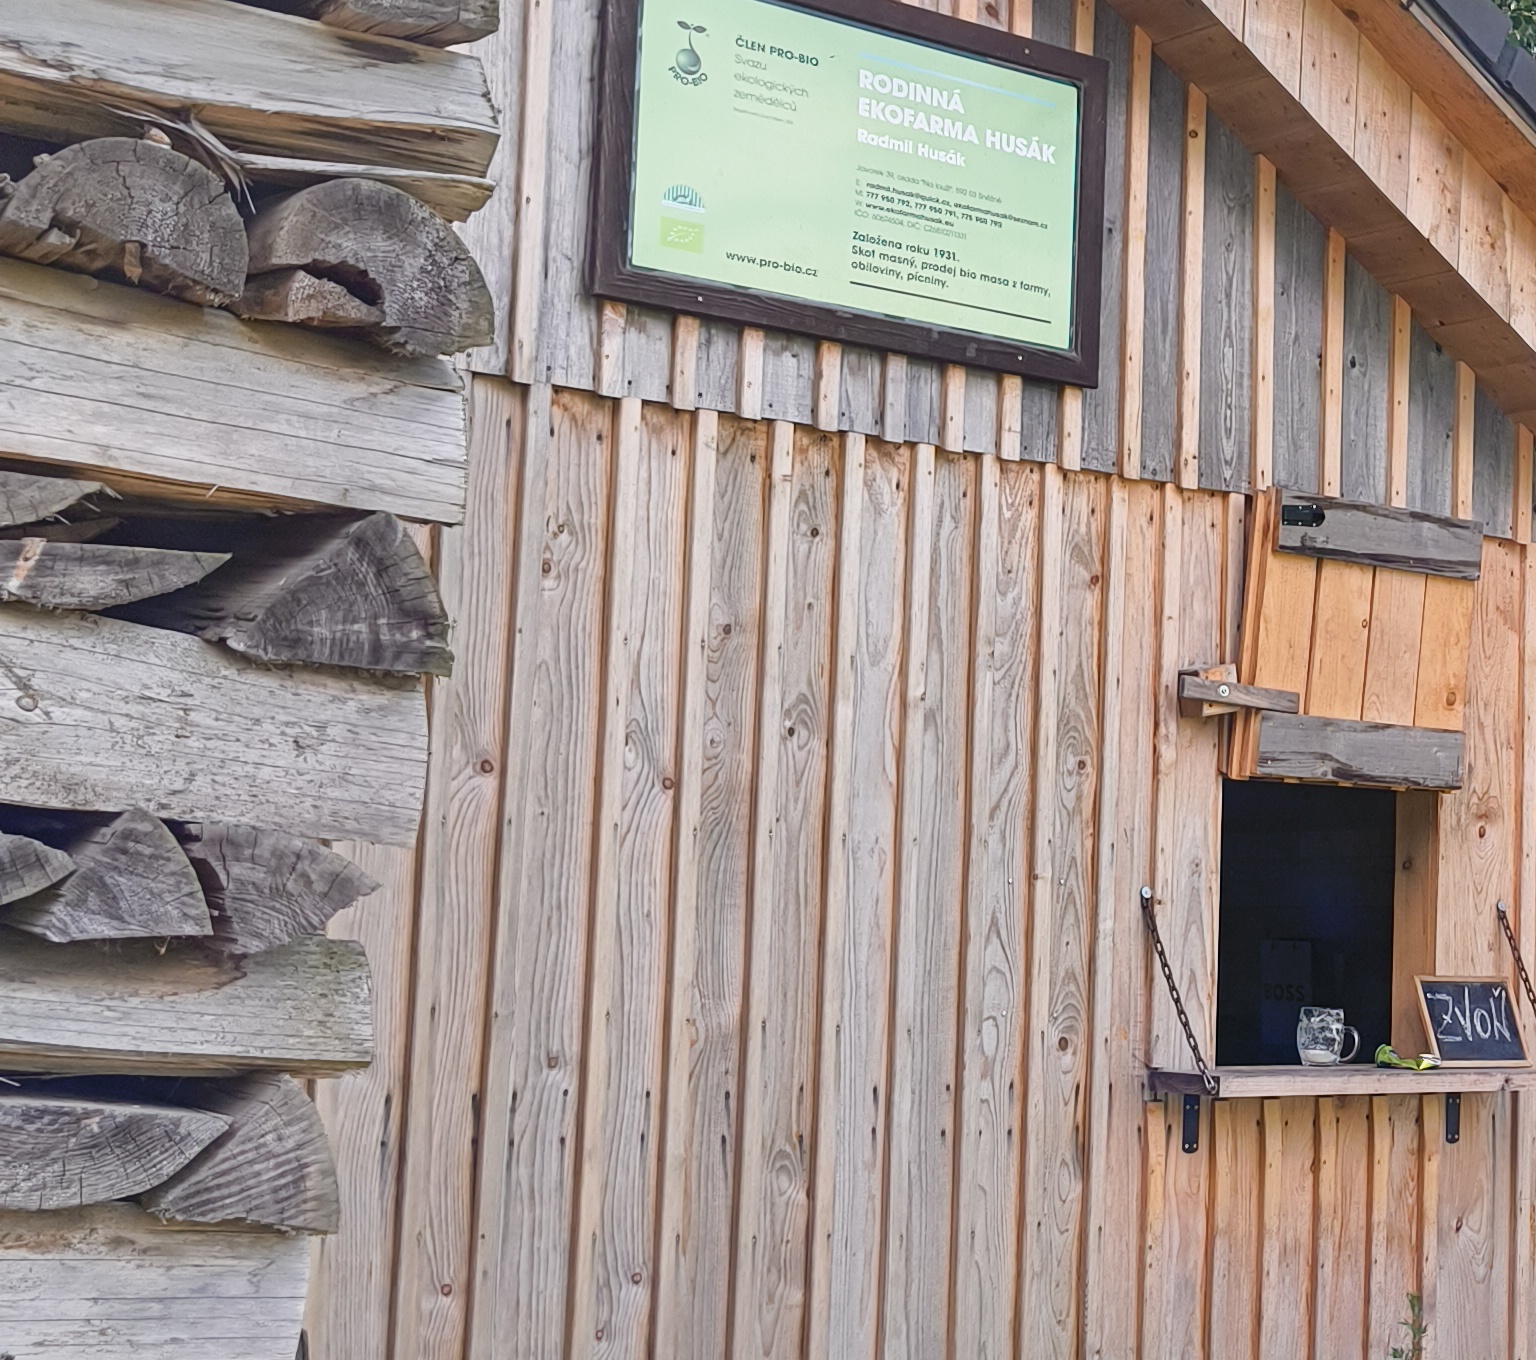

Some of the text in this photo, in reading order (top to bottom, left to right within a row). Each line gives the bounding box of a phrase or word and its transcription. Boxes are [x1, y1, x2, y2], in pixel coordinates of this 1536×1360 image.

[734, 53, 767, 71] Svazu
[735, 34, 819, 67] ČLEN PRO-BIO
[668, 65, 709, 87] PRO-BIO
[858, 69, 965, 114] RODINNÁ
[858, 97, 1057, 165] EKOFARMA HUSÁK
[857, 128, 967, 167] Radmil Husák
[866, 191, 879, 201] 777
[914, 201, 927, 211] 777
[852, 230, 960, 262] Založena roku 1931.
[725, 251, 819, 277] www.pro-bio.cz
[851, 244, 875, 259] Skot
[878, 252, 917, 269] masný,
[921, 261, 957, 277] prodej
[959, 267, 977, 280] bio
[980, 273, 1009, 286] masa
[851, 261, 904, 281] obiloviny,
